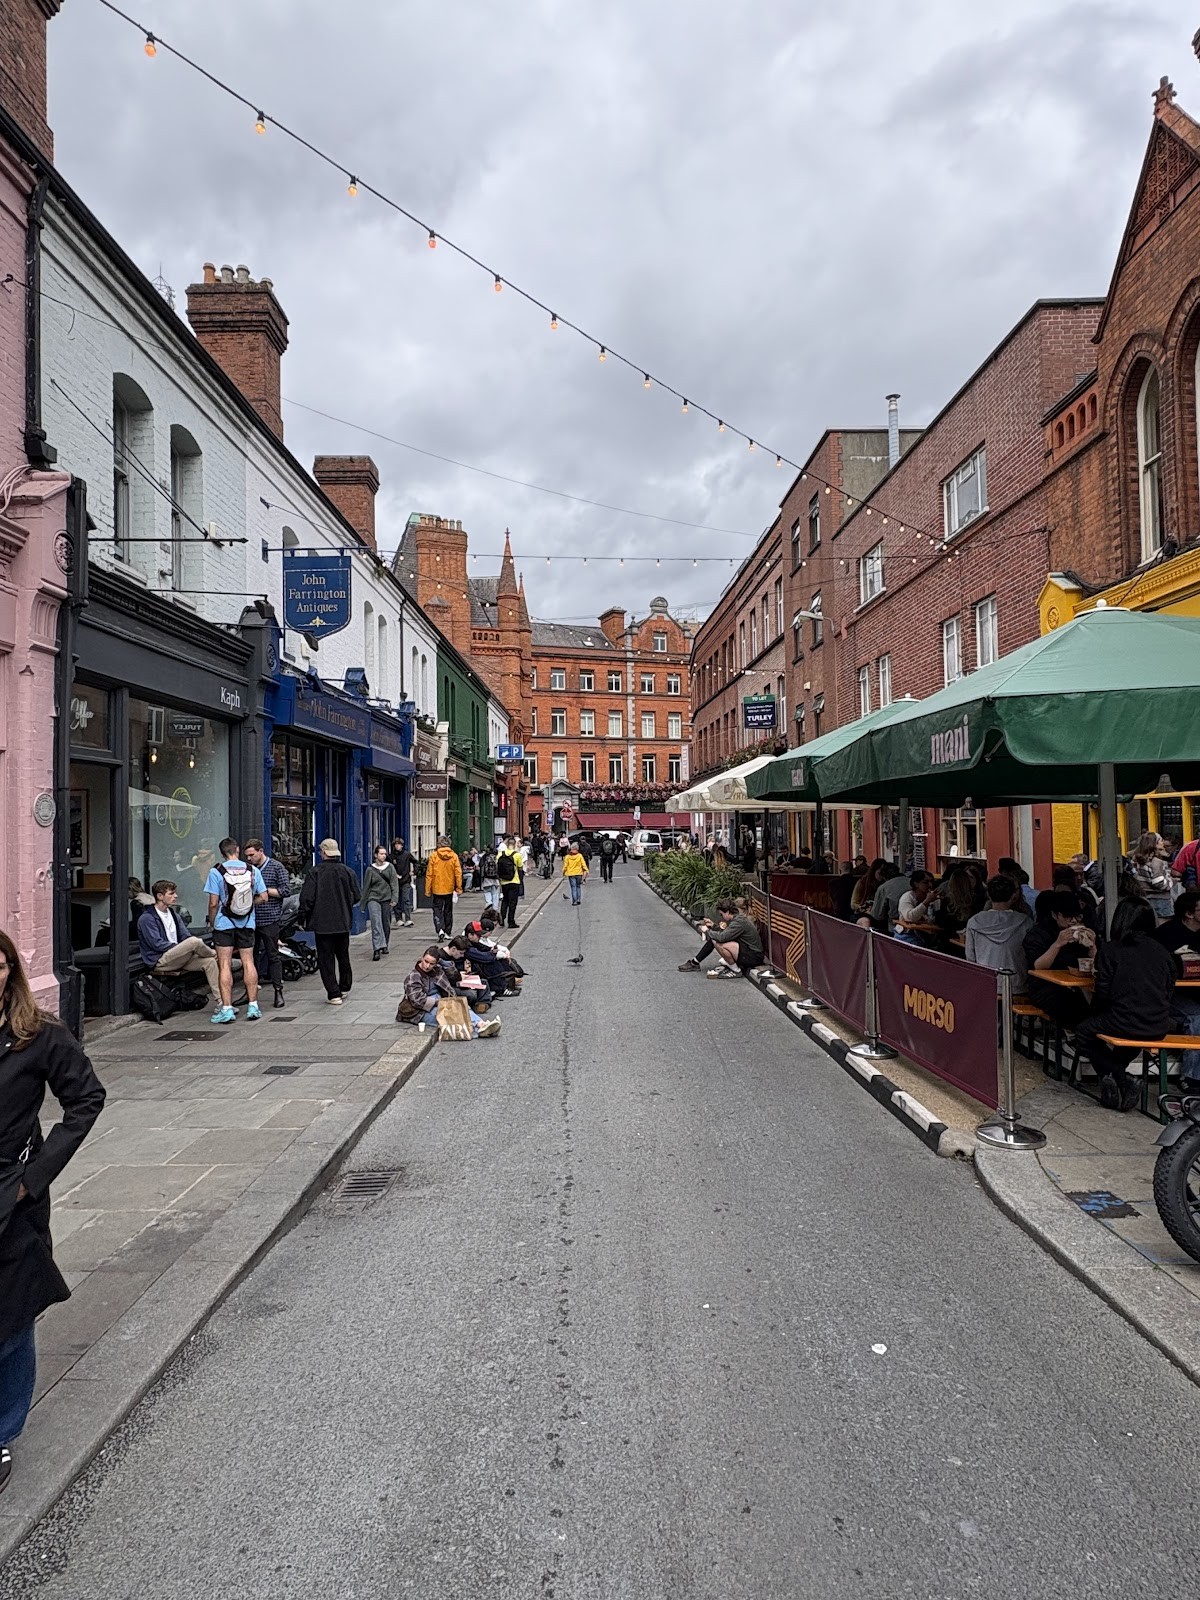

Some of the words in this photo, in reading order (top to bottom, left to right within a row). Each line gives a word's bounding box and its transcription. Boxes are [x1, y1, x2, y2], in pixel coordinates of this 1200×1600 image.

[302, 574, 326, 585] John
[289, 589, 346, 600] Farrington
[296, 602, 338, 613] Antiques
[220, 687, 240, 710] Kaph
[931, 714, 971, 766] mani
[513, 747, 520, 757] P
[415, 781, 447, 790] Cezanne
[903, 984, 954, 1033] MORSO
